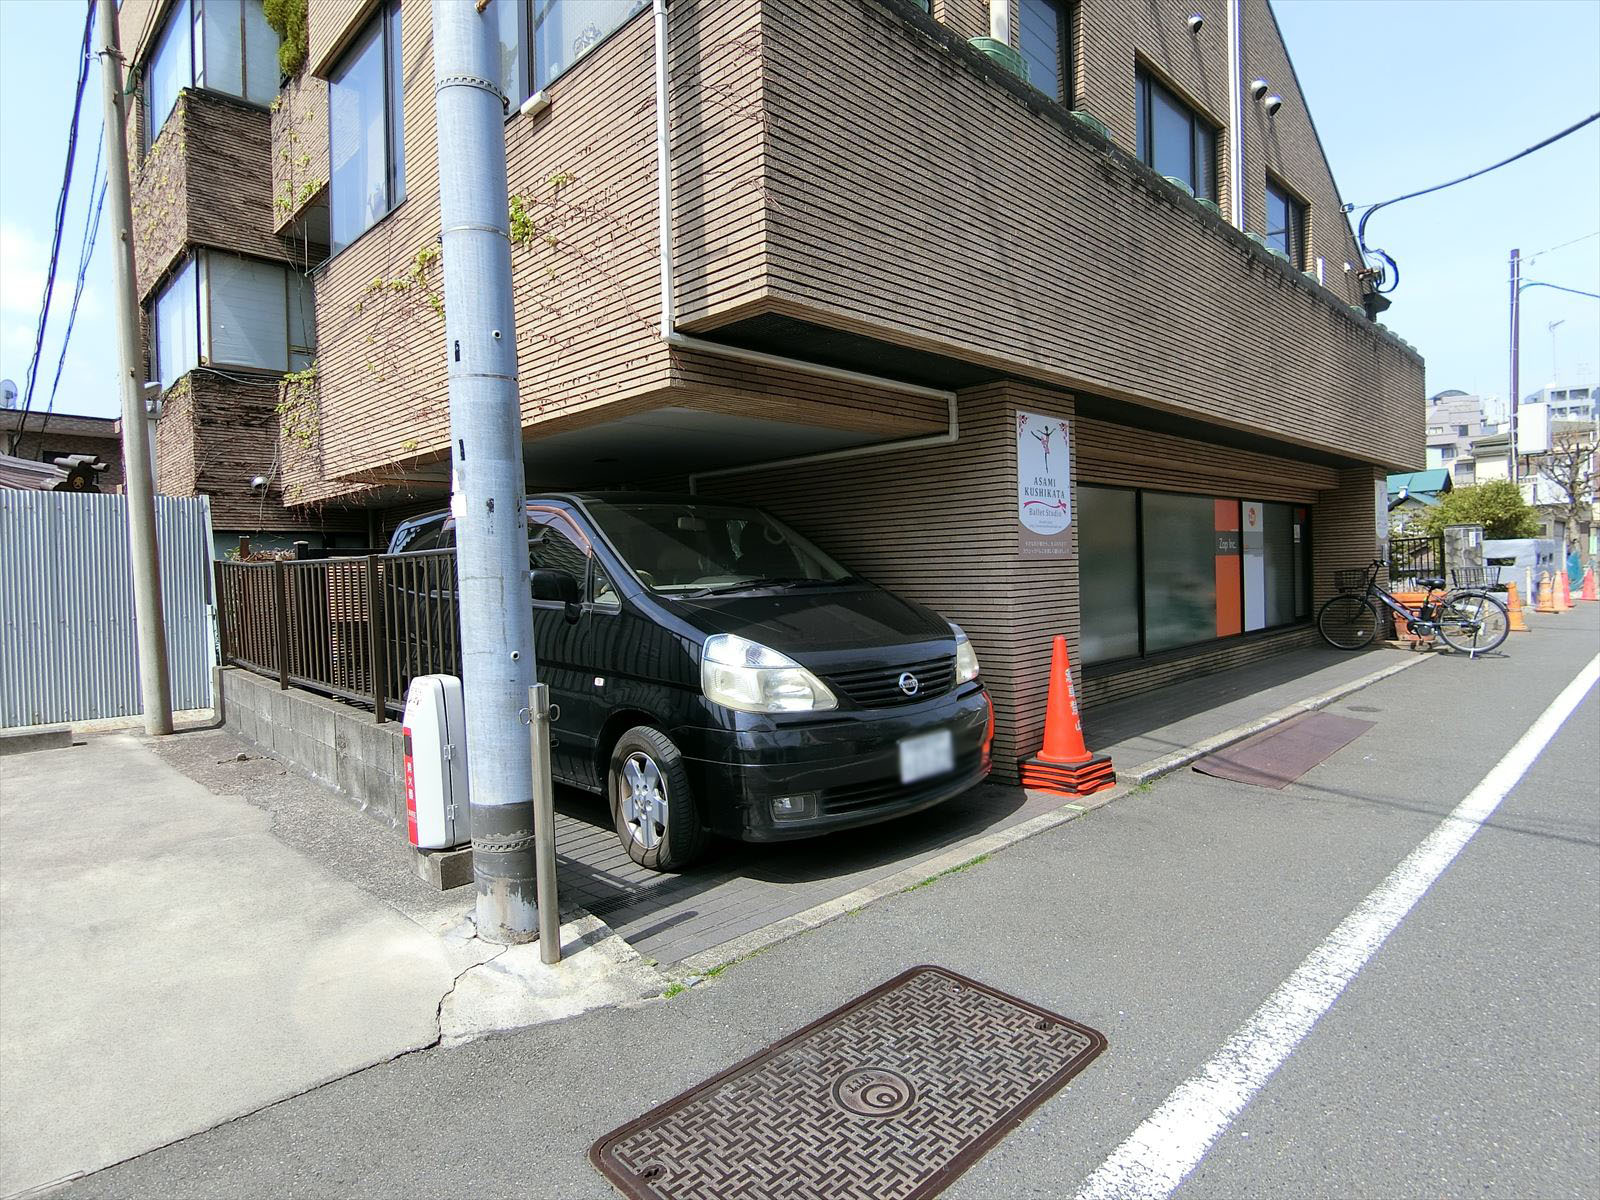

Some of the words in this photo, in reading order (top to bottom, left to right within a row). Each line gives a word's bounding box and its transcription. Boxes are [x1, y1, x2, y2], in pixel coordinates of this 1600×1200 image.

[1033, 476, 1056, 487] ASAMI
[1024, 486, 1065, 499] KUSHIKATA
[1028, 507, 1045, 516] Ballet
[1046, 508, 1062, 518] Studio
[845, 1073, 875, 1095] NTT
